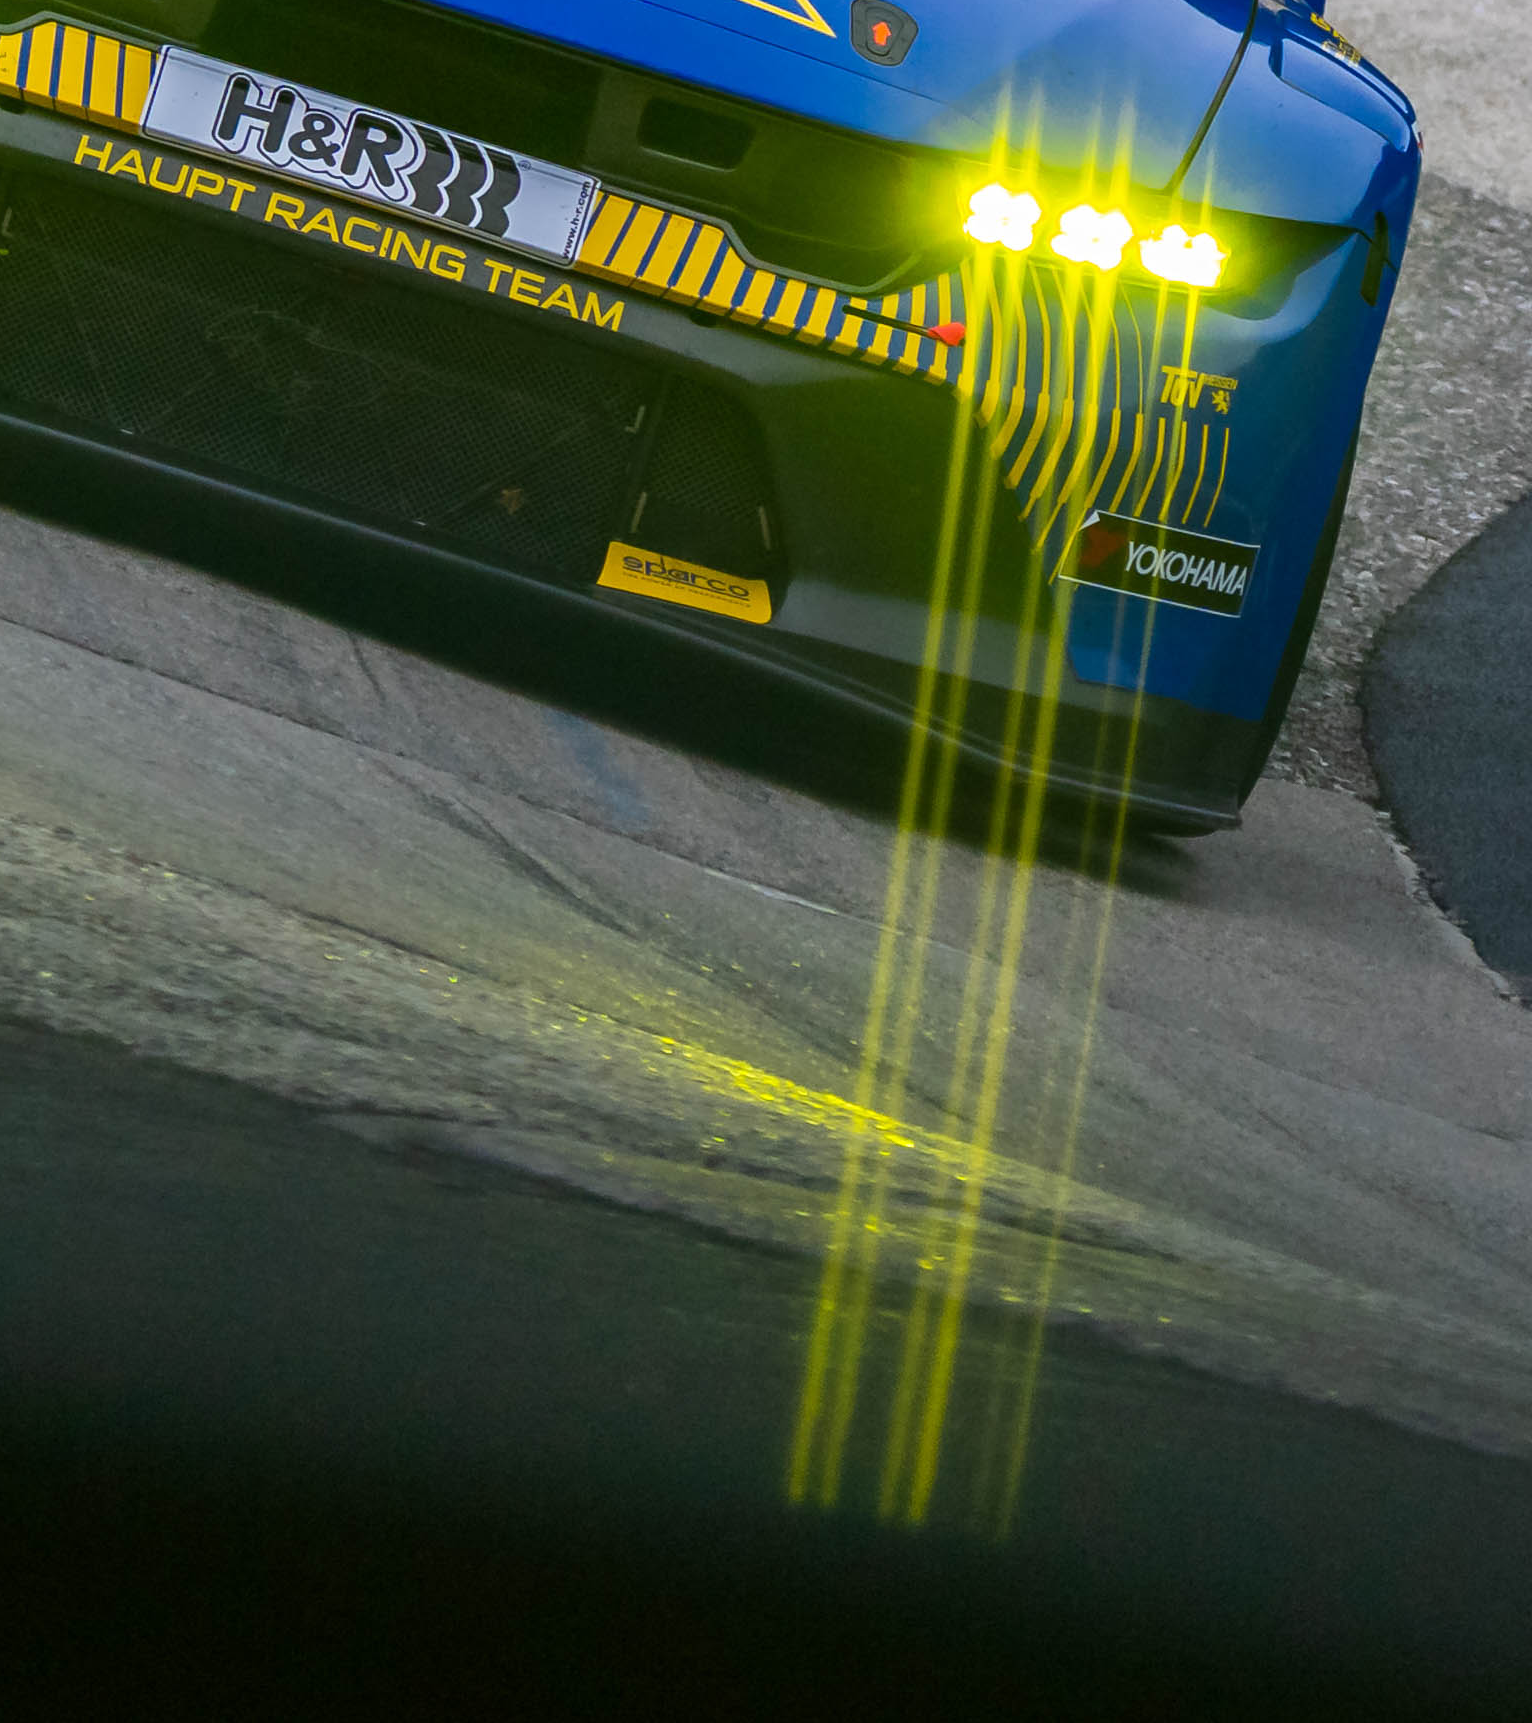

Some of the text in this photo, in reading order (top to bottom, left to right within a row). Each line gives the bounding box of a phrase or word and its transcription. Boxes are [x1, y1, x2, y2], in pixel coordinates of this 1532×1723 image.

[217, 74, 408, 190] H&R
[73, 134, 627, 332] HAUPT RACING TEAM
[562, 180, 591, 259] www.h-r.com
[622, 555, 750, 598] sparco
[1124, 540, 1247, 596] YOKOHAMA
